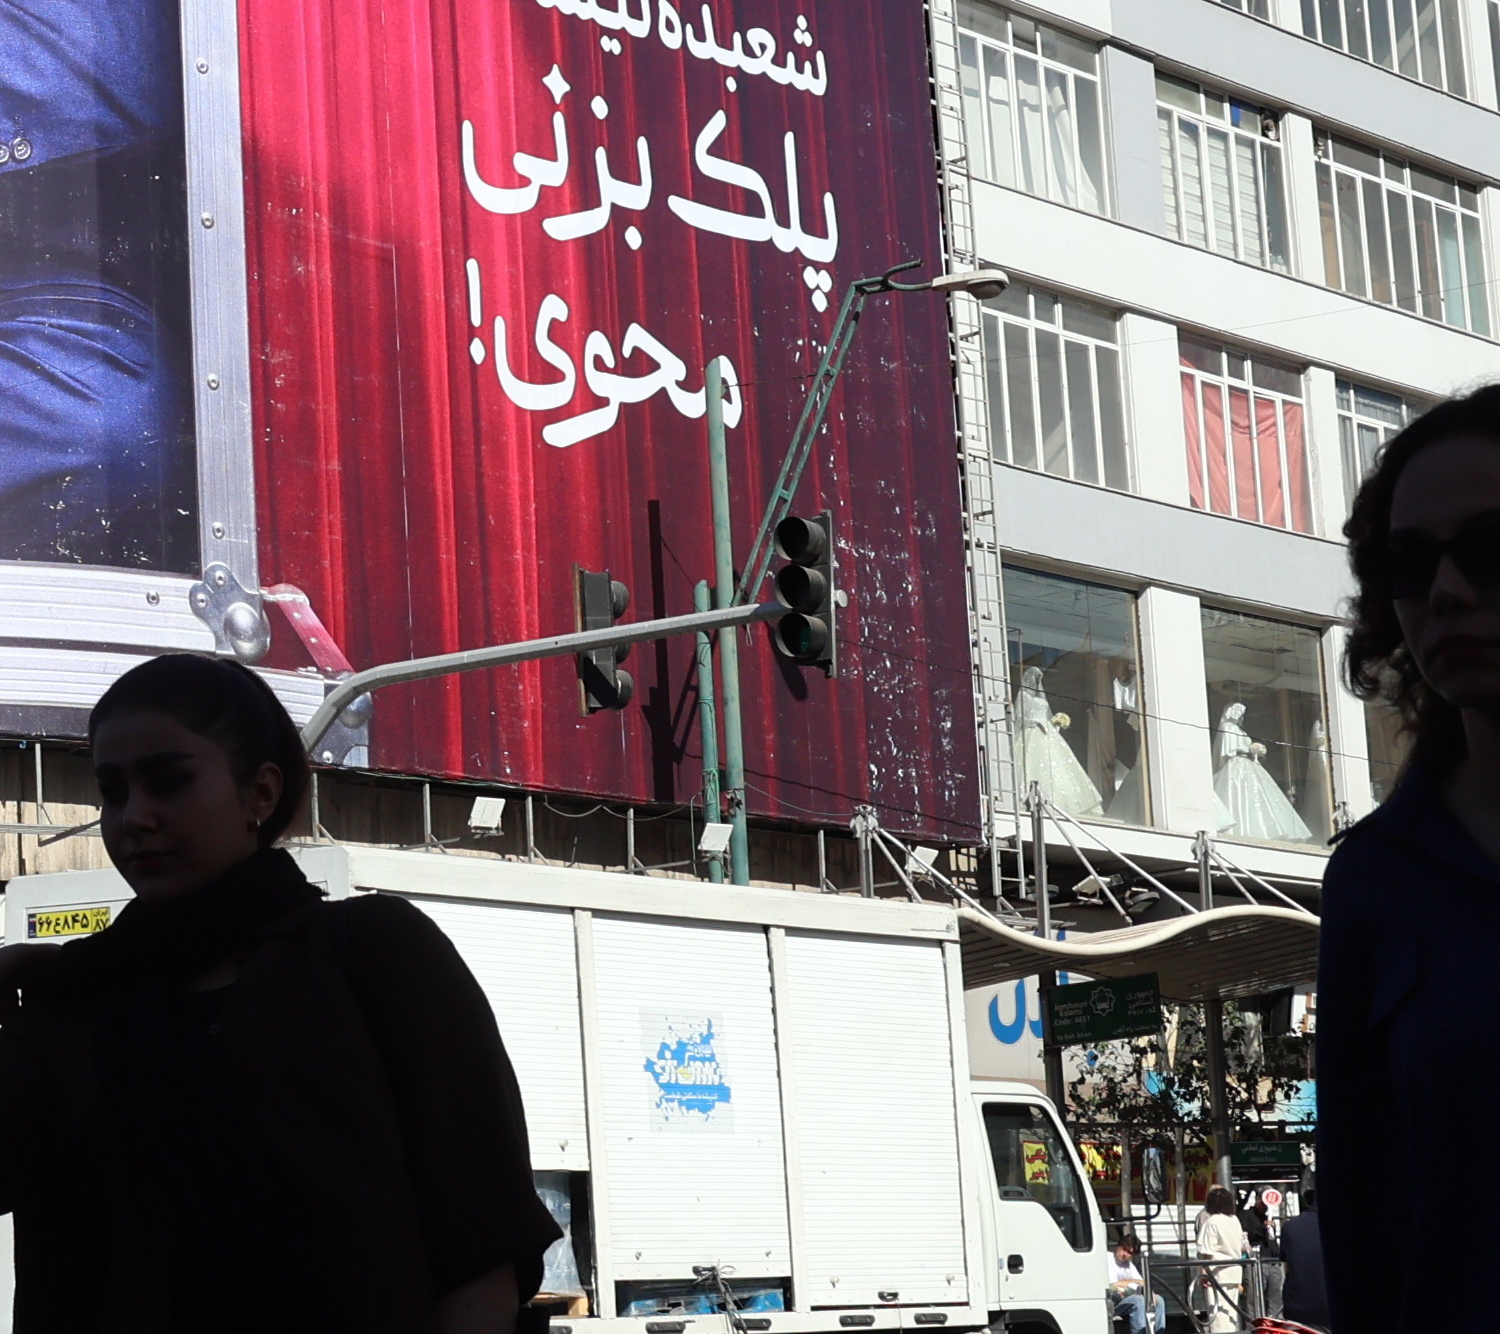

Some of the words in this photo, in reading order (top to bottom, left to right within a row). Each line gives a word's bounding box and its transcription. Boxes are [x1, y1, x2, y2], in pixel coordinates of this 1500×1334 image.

[462, 64, 654, 250] بزنی
[667, 110, 839, 312] پلک
[466, 259, 743, 449] محوی!
